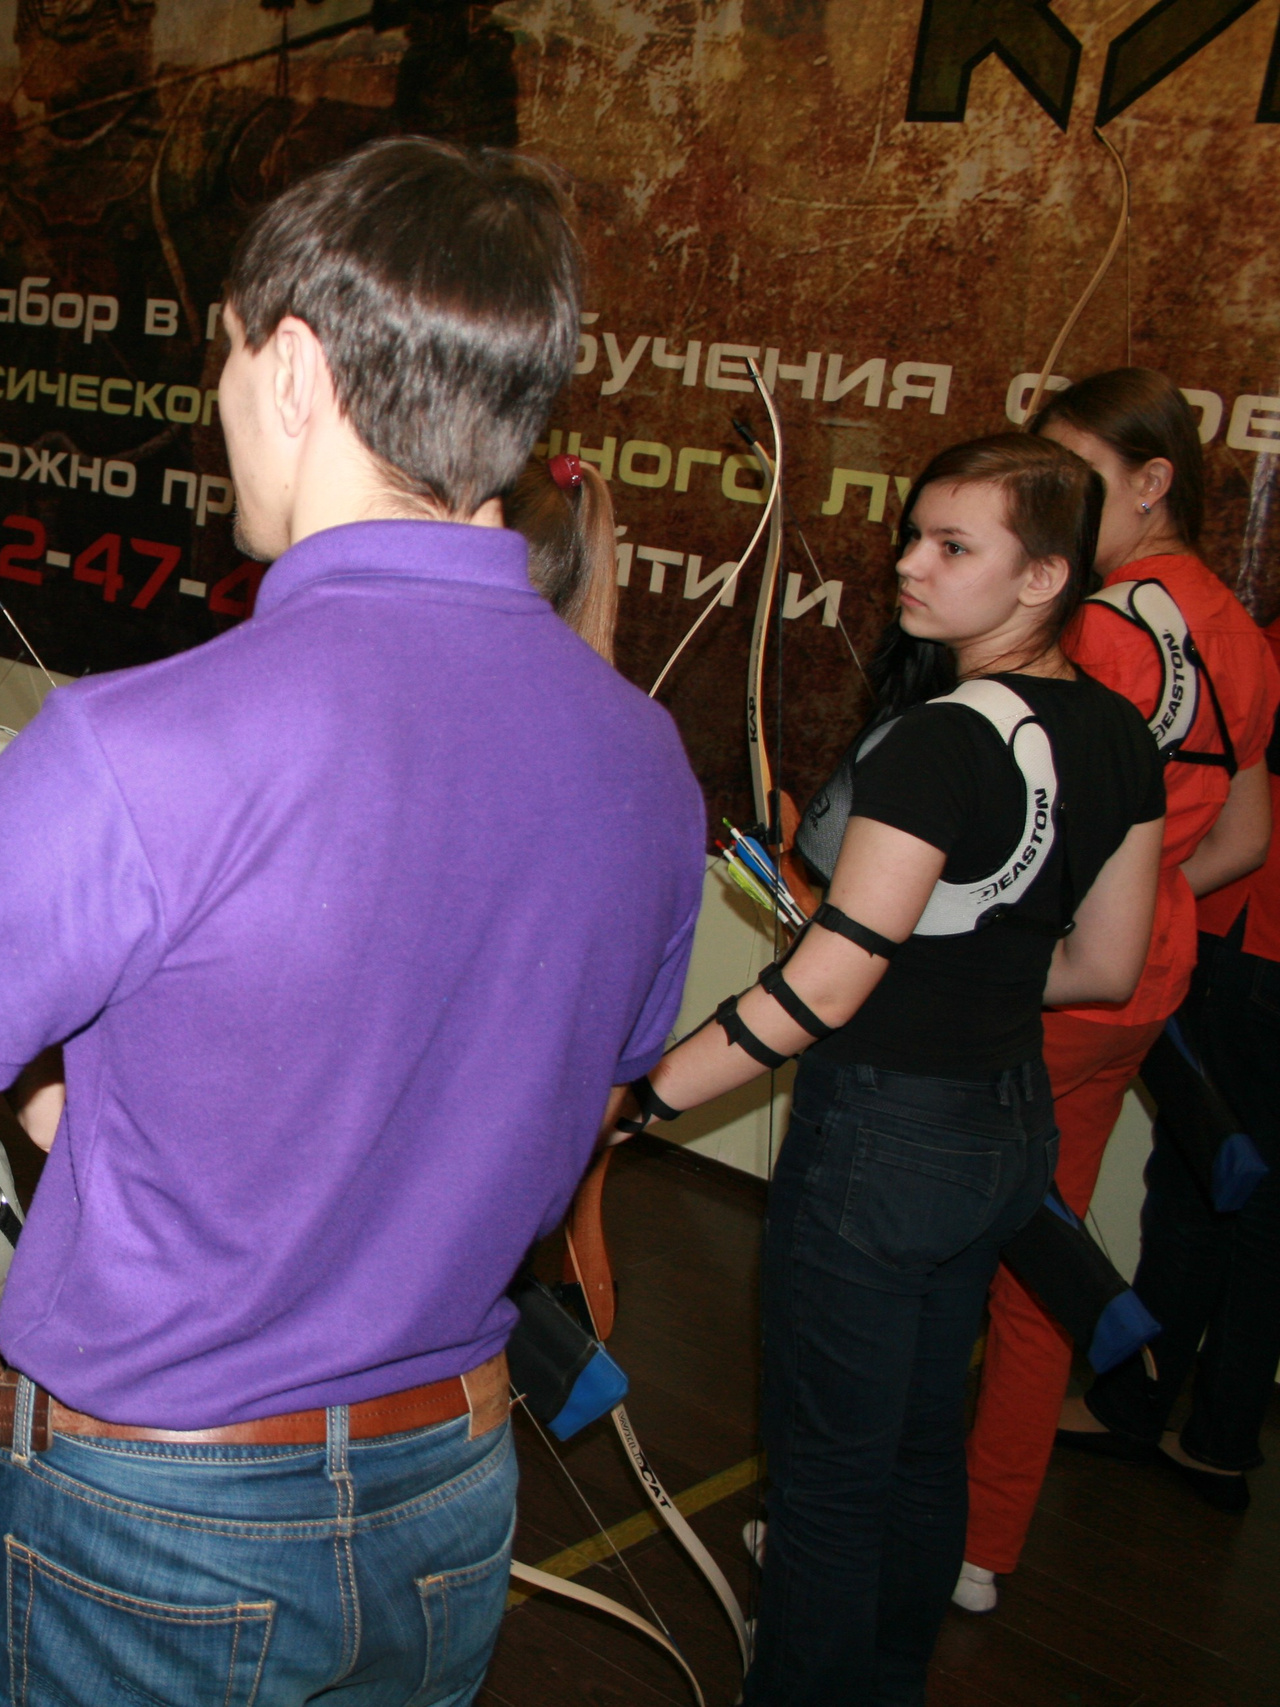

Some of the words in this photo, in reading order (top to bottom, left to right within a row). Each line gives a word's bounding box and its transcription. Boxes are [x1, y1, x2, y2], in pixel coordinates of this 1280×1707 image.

[144, 297, 179, 337] в
[161, 468, 235, 527] пр
[1161, 632, 1185, 730] EASTON
[998, 788, 1049, 891] EASTON
